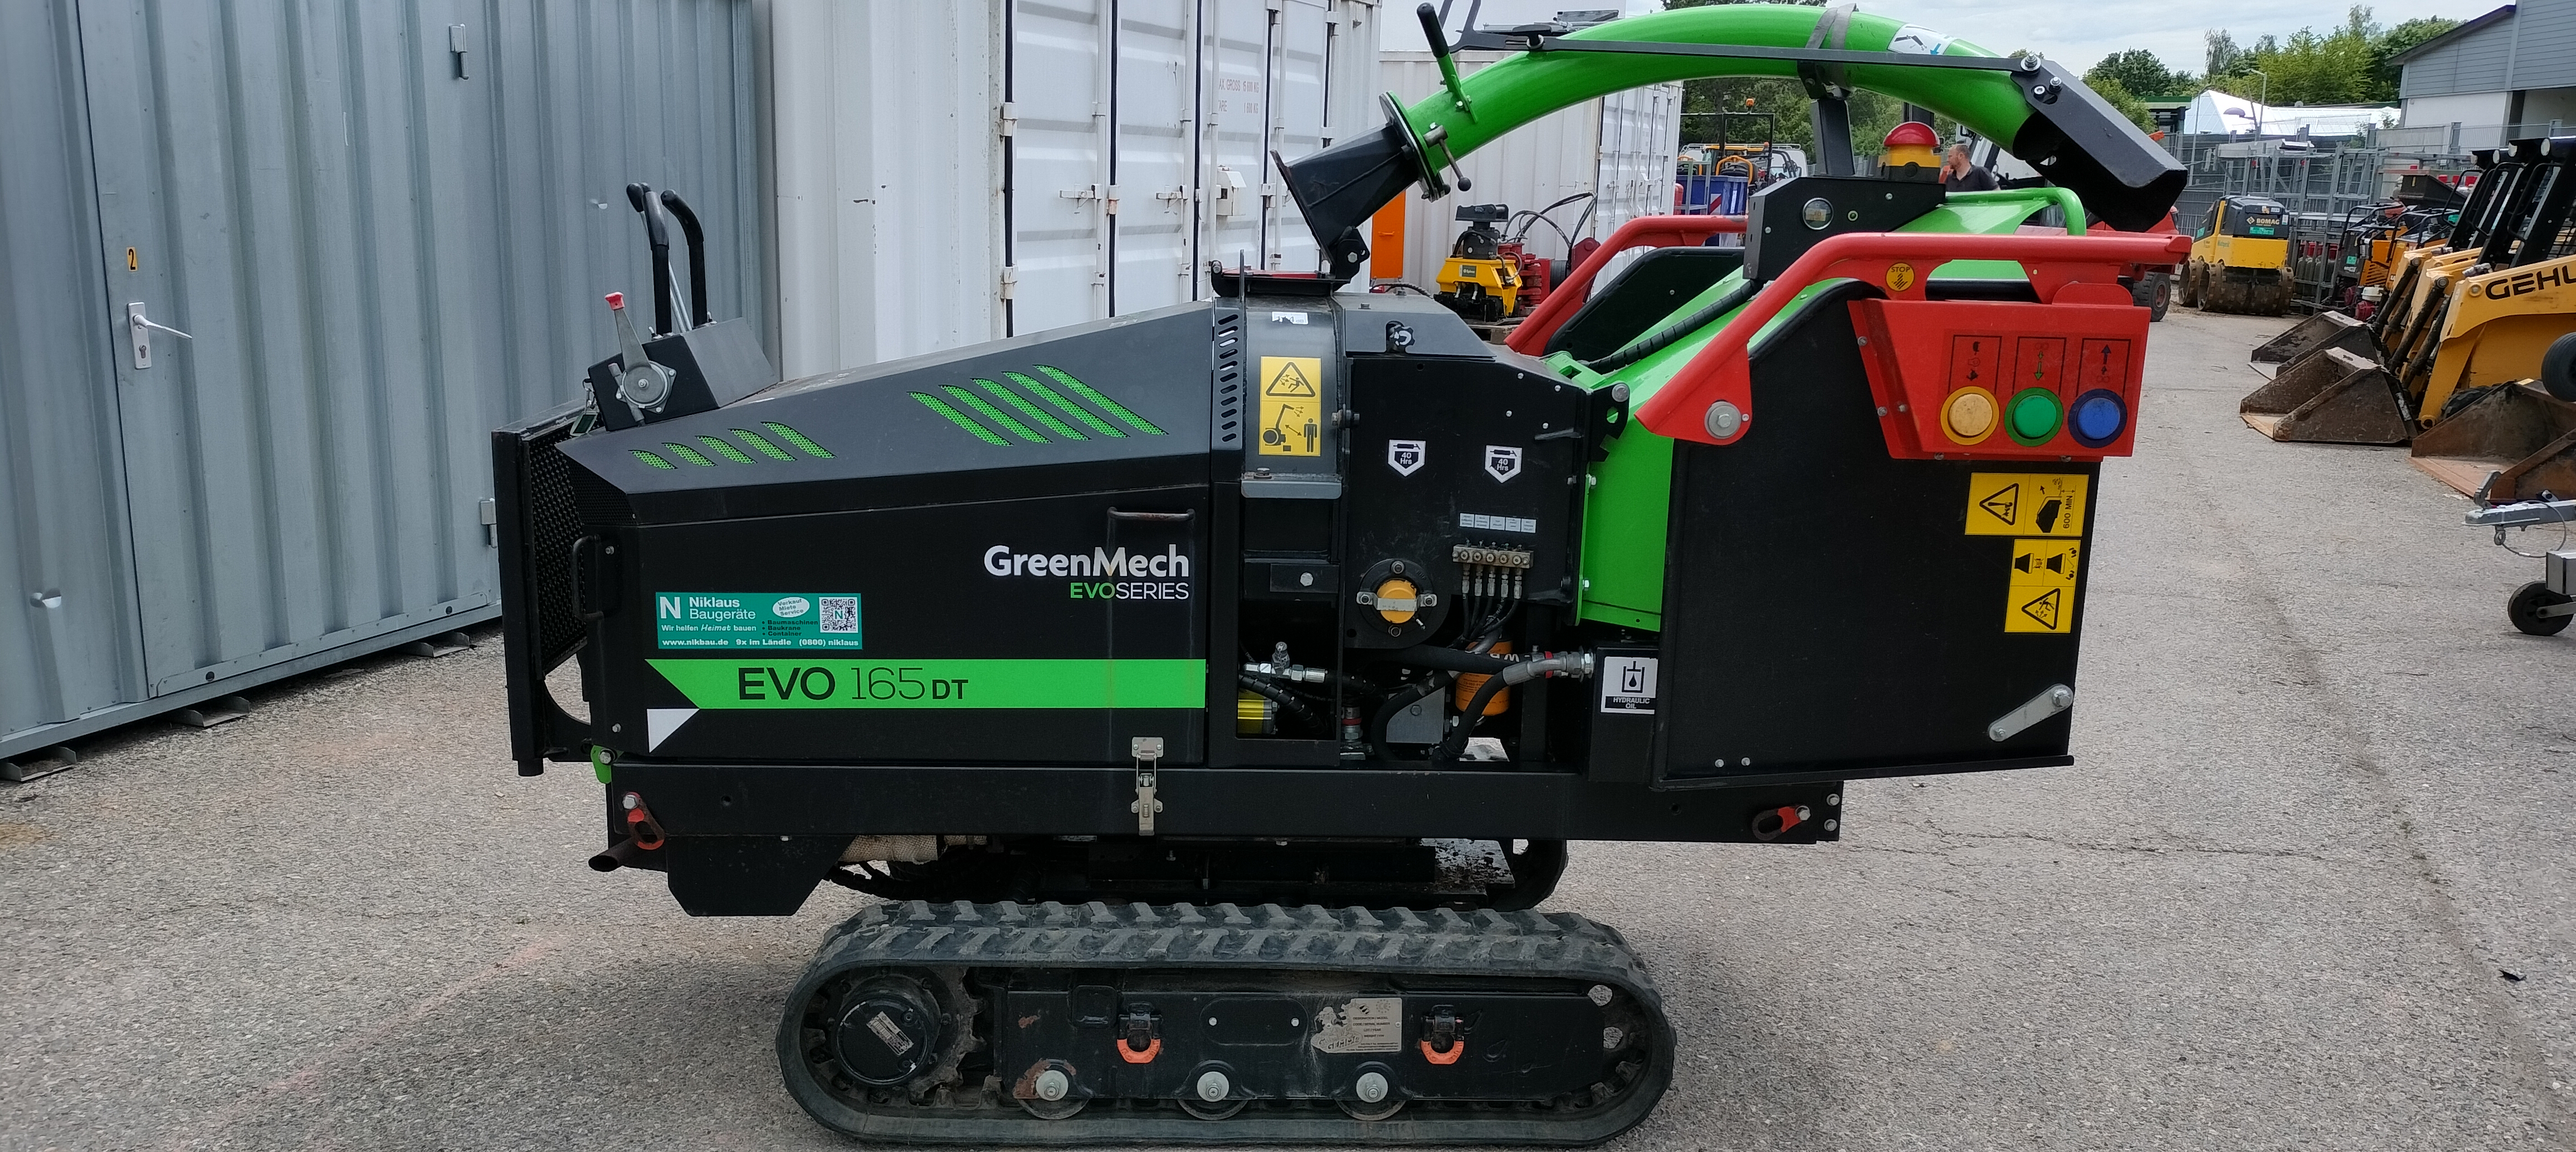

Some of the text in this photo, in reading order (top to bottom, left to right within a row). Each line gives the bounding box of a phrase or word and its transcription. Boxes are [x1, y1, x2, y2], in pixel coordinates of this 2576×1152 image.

[1227, 79, 1240, 91] GROSS
[1218, 100, 1227, 112] ARE
[129, 248, 135, 270] 2
[2063, 495, 2073, 529] 600 MIN
[984, 544, 1189, 578] GreenMech
[660, 596, 681, 619] N
[689, 597, 740, 608] Niklaus
[778, 598, 803, 607] Verkauf
[690, 608, 757, 622] Baugeräte
[701, 623, 731, 632] Heimat
[799, 638, 826, 647] (0800)
[738, 667, 969, 701] EVO 165 DT
